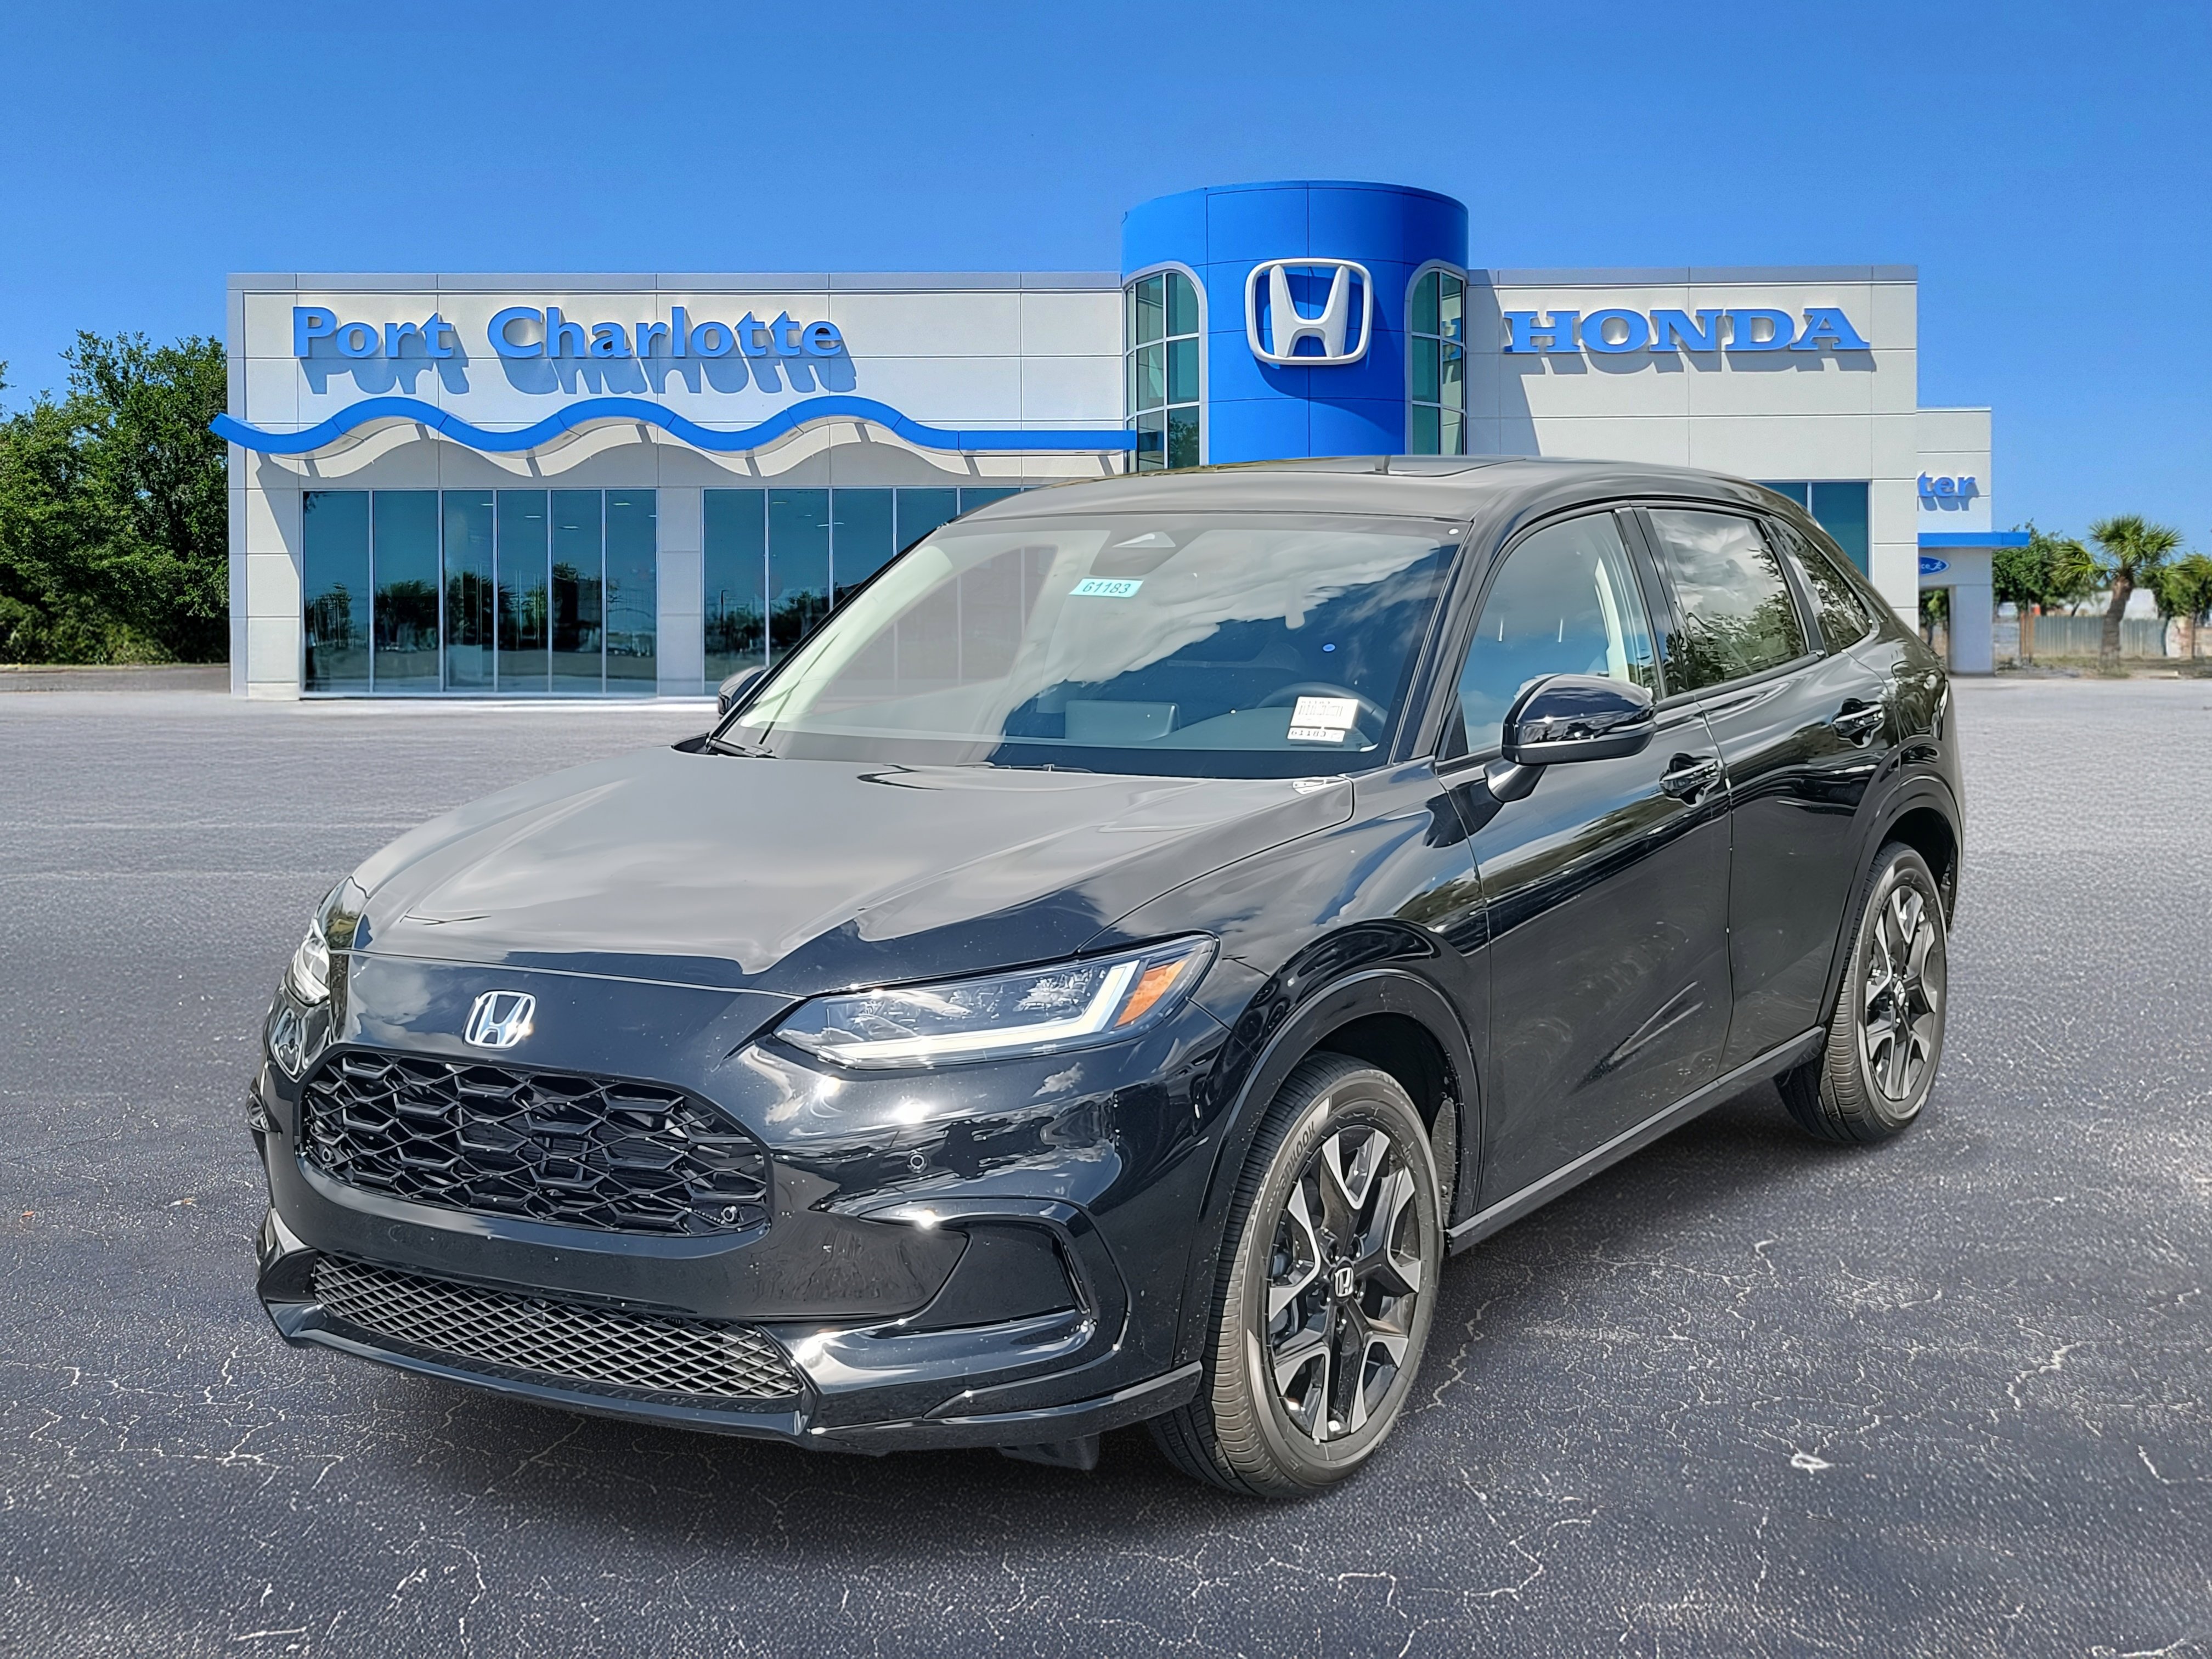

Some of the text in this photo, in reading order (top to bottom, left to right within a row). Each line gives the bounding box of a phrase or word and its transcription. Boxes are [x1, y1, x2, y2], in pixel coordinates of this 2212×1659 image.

[292, 305, 843, 358] Port Charlotte
[1503, 308, 1871, 353] HONDA
[1082, 582, 1132, 594] 61183
